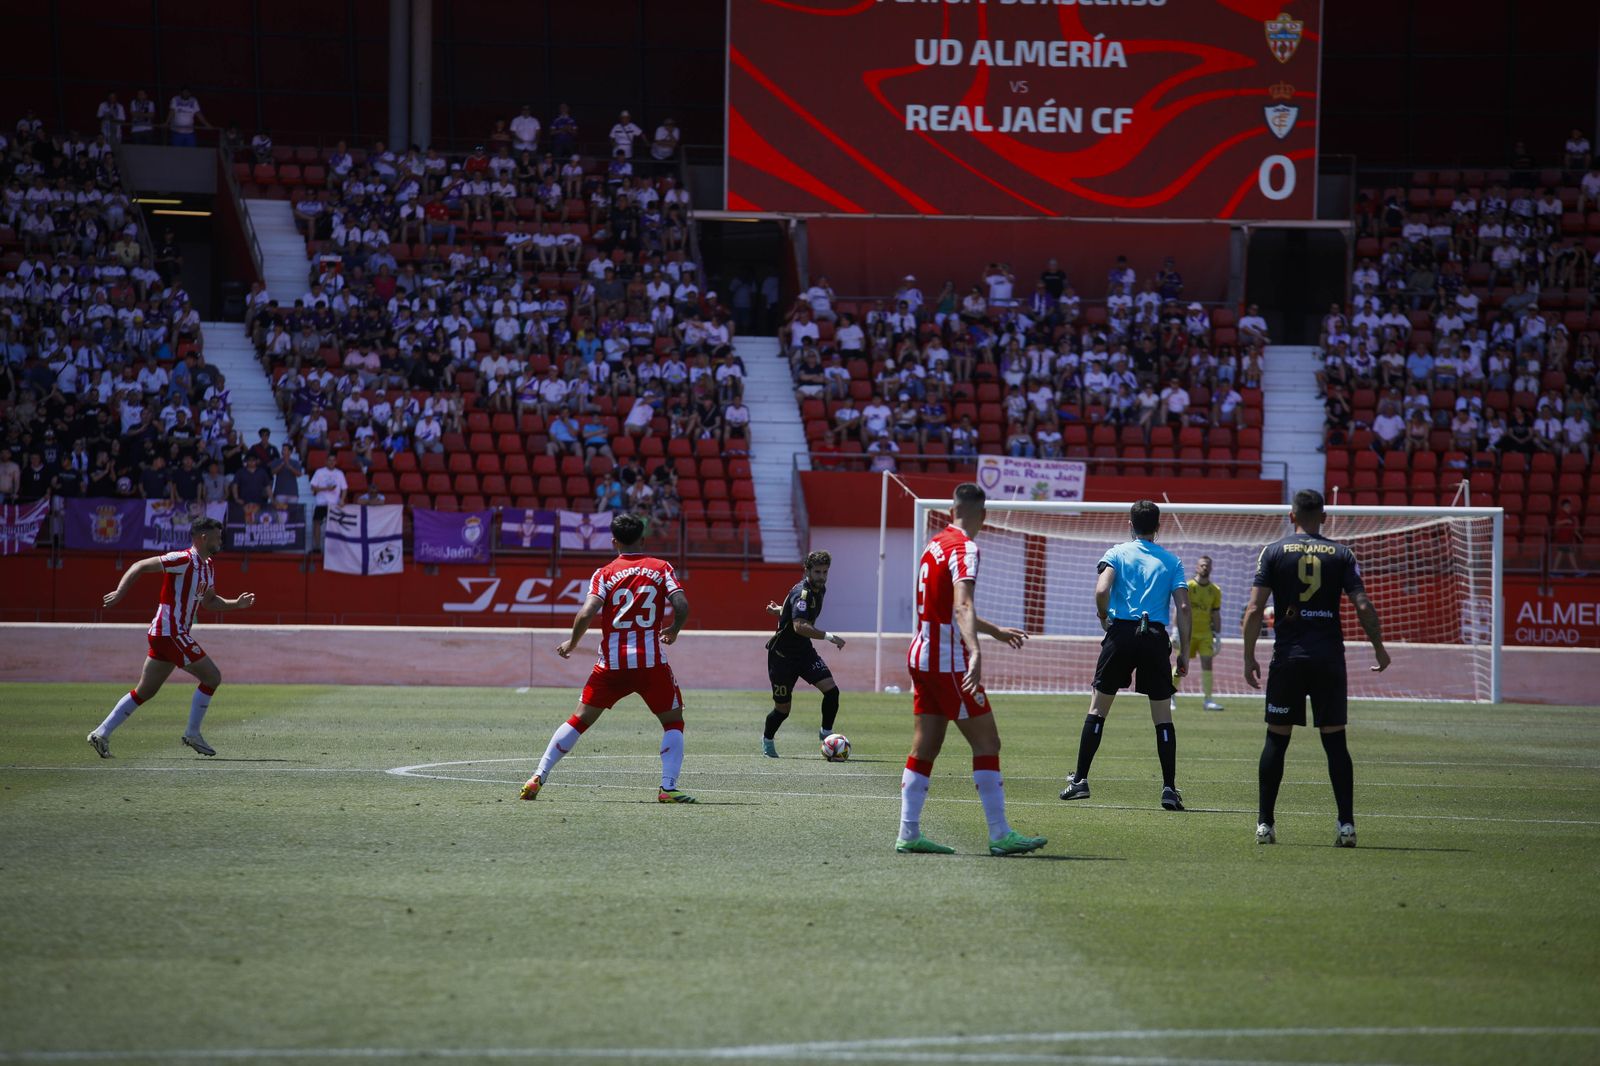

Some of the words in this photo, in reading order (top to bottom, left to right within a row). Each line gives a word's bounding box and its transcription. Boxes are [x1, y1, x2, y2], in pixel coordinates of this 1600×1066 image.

[914, 38, 963, 66] UD
[969, 33, 1128, 68] ALMERÍA
[905, 104, 993, 132] REAL
[997, 98, 1083, 133] JAÉN
[1091, 107, 1133, 134] CF
[1258, 154, 1297, 200] 0
[1283, 543, 1336, 555] FERNANDO
[605, 566, 641, 591] MARCOS
[641, 567, 664, 586] PEÑA
[1297, 554, 1322, 602] 9
[612, 585, 657, 629] 23
[1516, 601, 1600, 625] ALME
[1515, 627, 1580, 644] CIUDAD
[774, 685, 787, 696] 20
